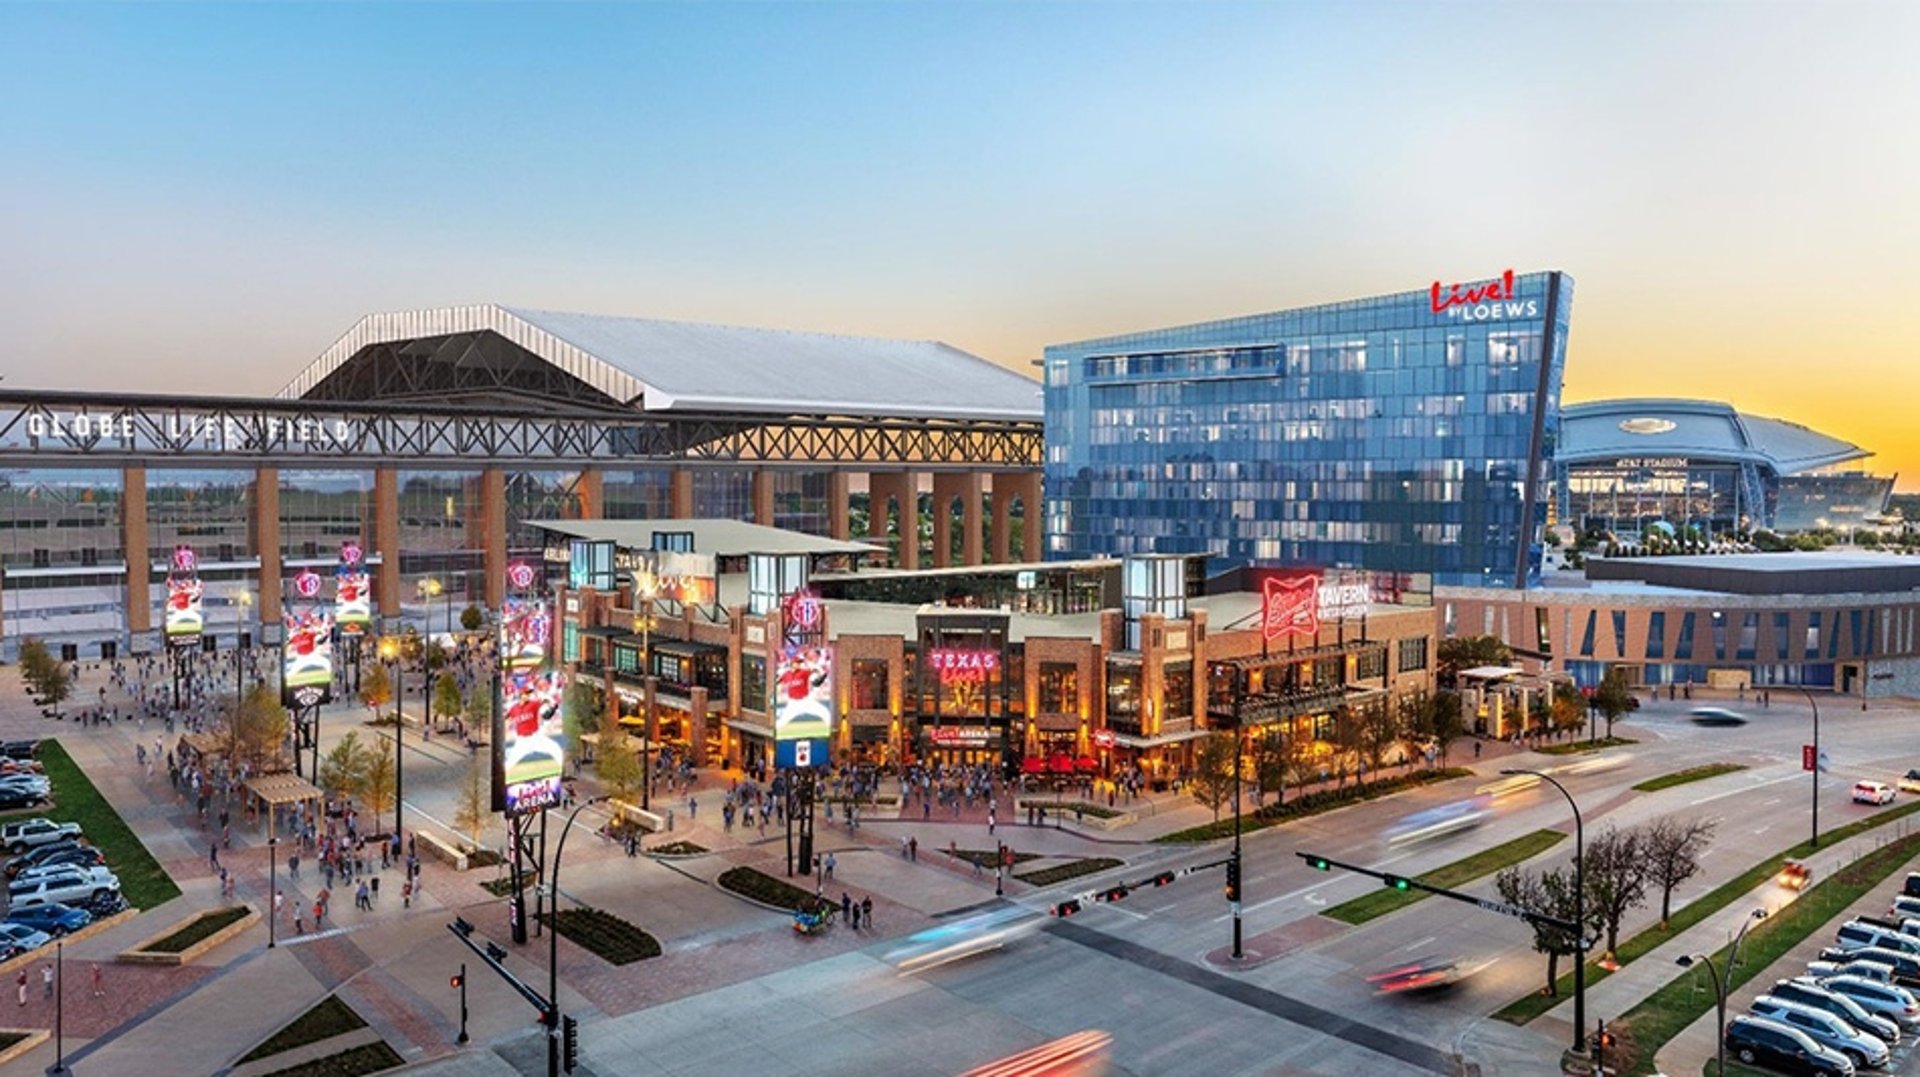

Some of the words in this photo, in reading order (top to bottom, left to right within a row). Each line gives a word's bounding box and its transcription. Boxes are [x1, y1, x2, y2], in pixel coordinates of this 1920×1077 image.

[1431, 269, 1513, 313] Live!
[1448, 307, 1462, 317] BY
[1463, 300, 1537, 320] LOEWS
[29, 414, 134, 437] GLOBE
[171, 417, 236, 439] LIFE
[267, 420, 348, 441] FIELD
[1318, 583, 1369, 606] TAVERN
[932, 653, 994, 669] TEXAS
[513, 791, 555, 811] ARENA
